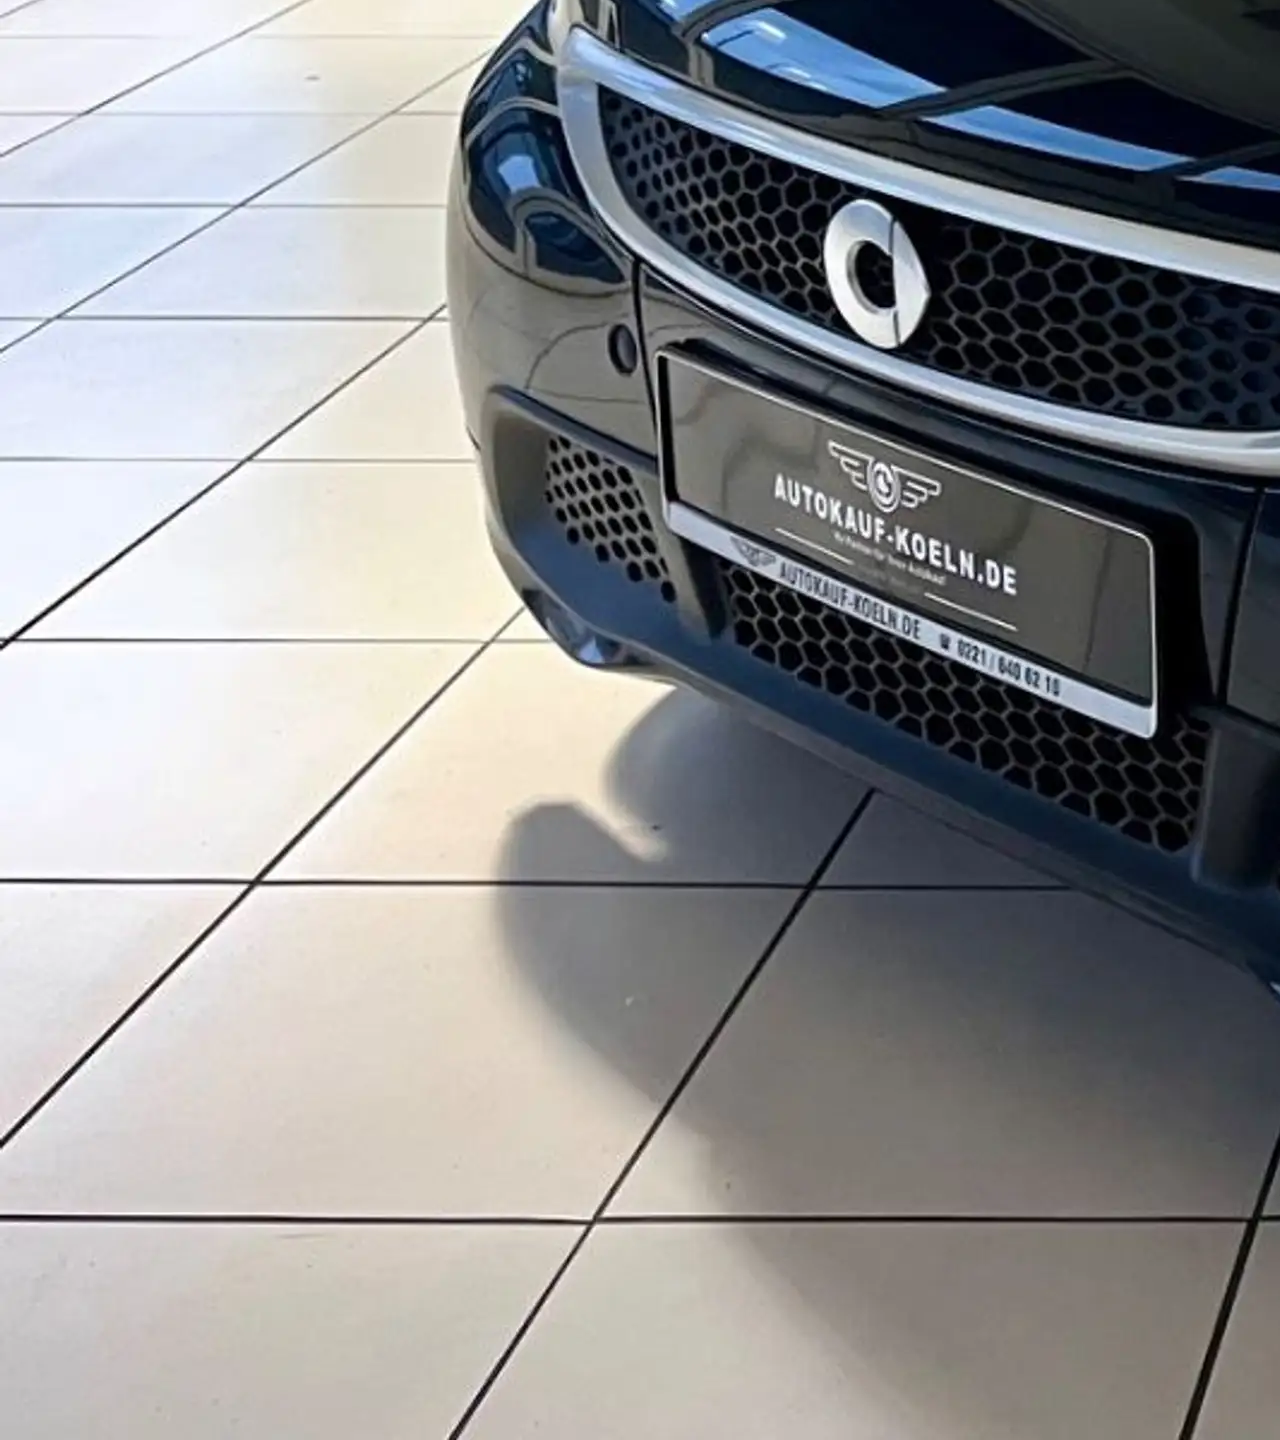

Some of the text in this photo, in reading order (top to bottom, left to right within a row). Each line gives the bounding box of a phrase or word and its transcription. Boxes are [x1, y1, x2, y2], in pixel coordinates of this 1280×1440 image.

[774, 472, 1018, 596] AUTOKAUF-KOELN.DE
[779, 561, 921, 640] AUTOKAUF-KOELN.DE
[957, 636, 986, 666] 0221
